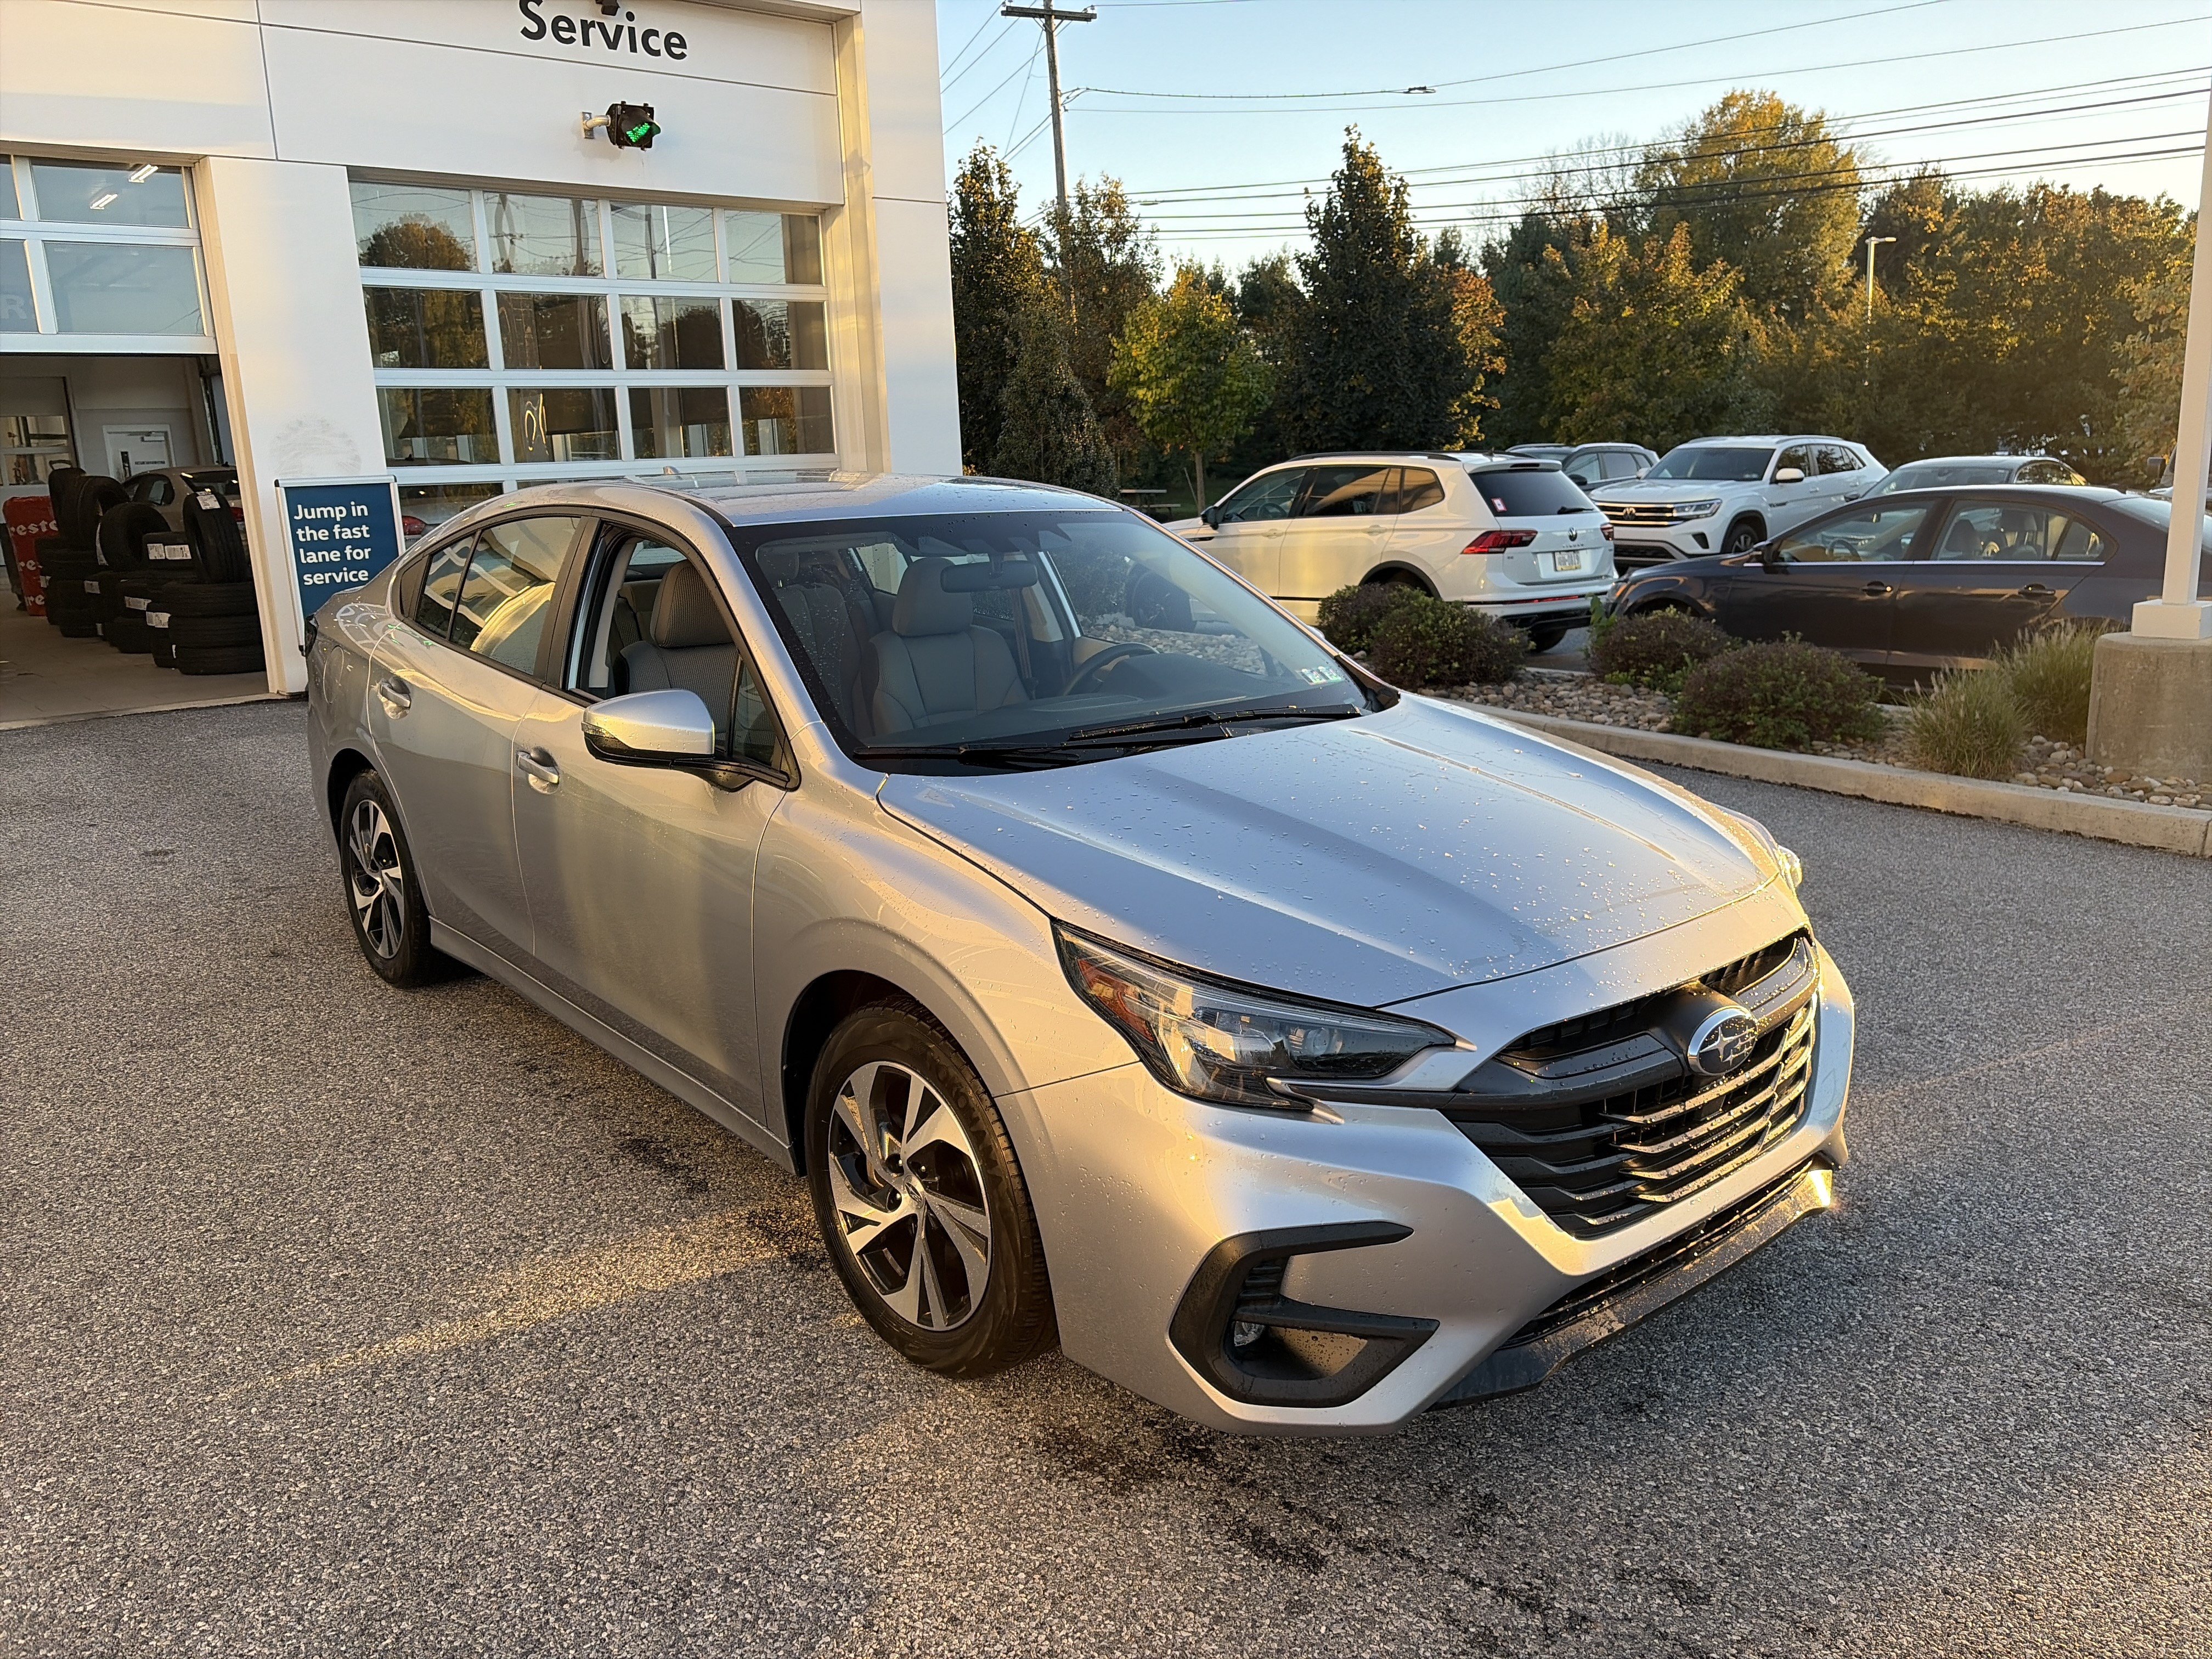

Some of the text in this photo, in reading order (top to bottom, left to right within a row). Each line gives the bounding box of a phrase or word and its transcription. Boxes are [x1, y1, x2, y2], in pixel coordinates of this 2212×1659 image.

[519, 0, 687, 60] Service
[294, 501, 368, 521] Jump in
[296, 524, 370, 541] the fast
[300, 545, 371, 563] lane for
[303, 567, 369, 585] service
